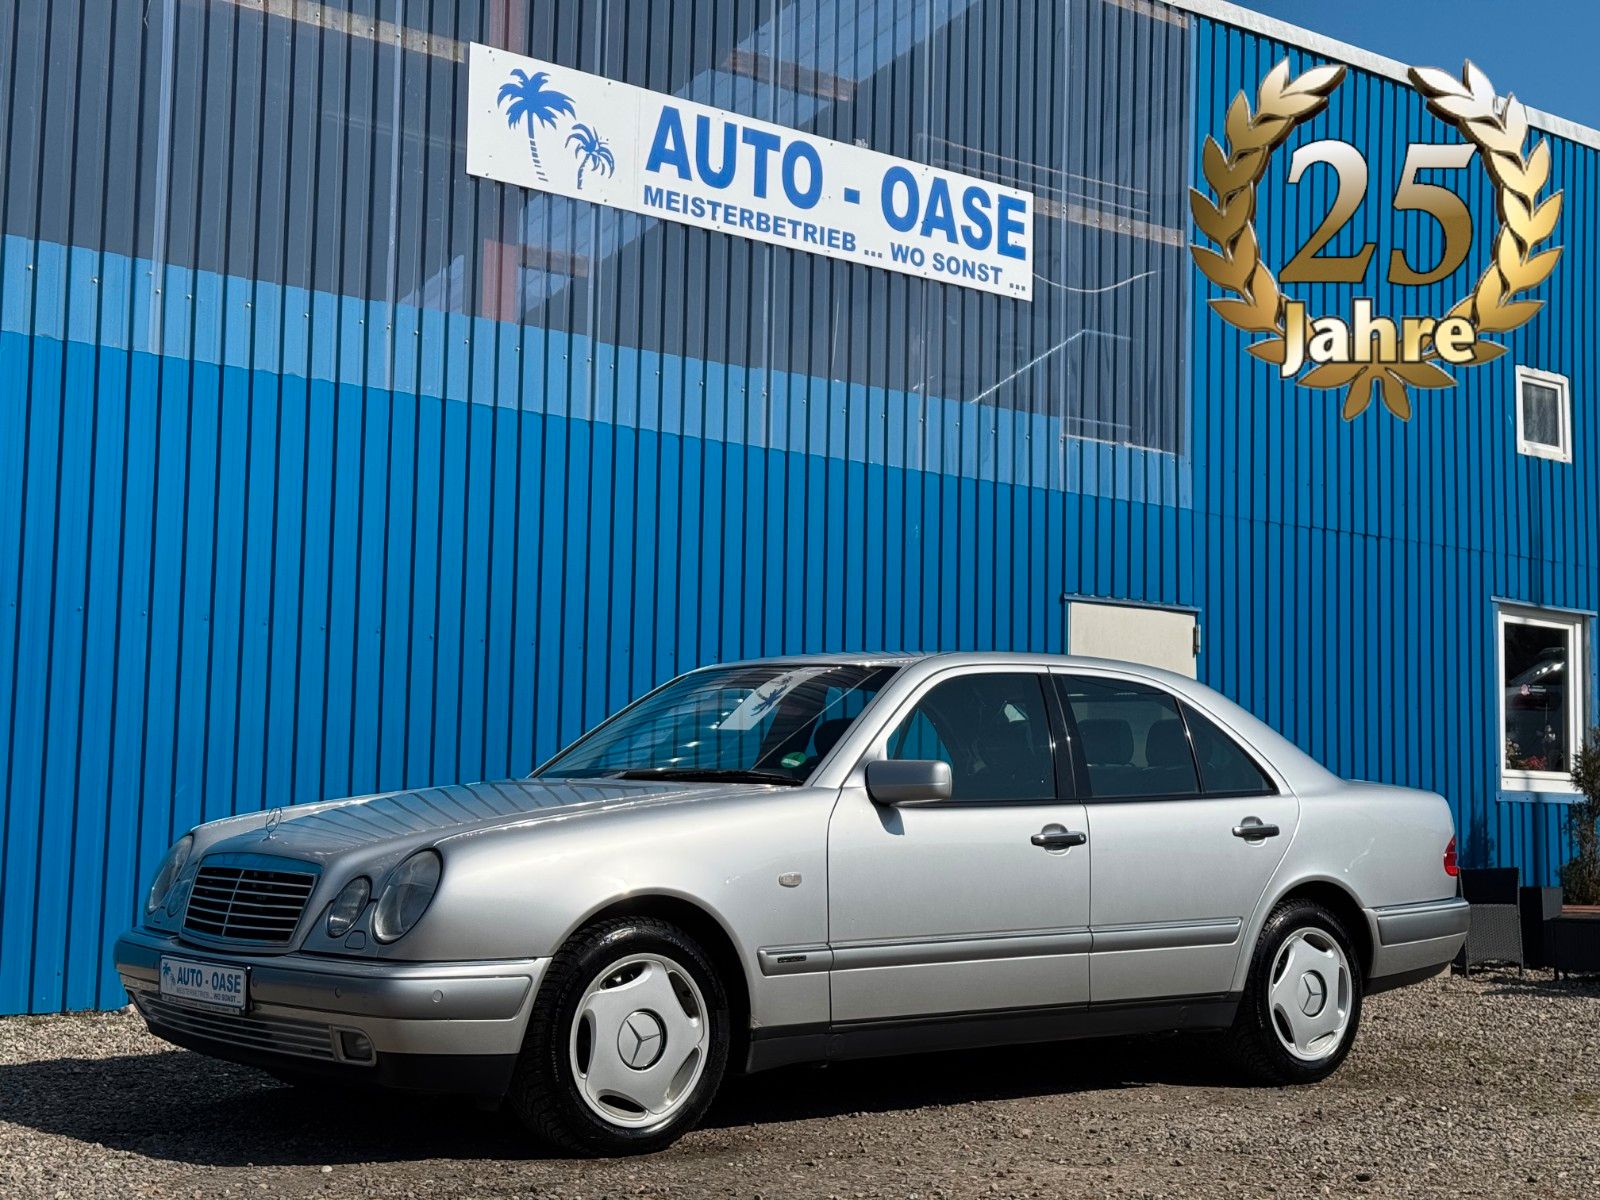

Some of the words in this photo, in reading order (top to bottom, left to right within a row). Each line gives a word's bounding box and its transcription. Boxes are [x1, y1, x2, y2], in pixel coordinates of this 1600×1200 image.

[645, 105, 823, 210] AUTO
[843, 187, 860, 204] -
[880, 165, 1027, 261] OASE
[643, 184, 856, 252] MEISTERBETRIEB
[890, 241, 925, 267] WO
[932, 252, 1003, 286] SONST
[177, 966, 203, 987] AUTO
[211, 972, 242, 993] OASE
